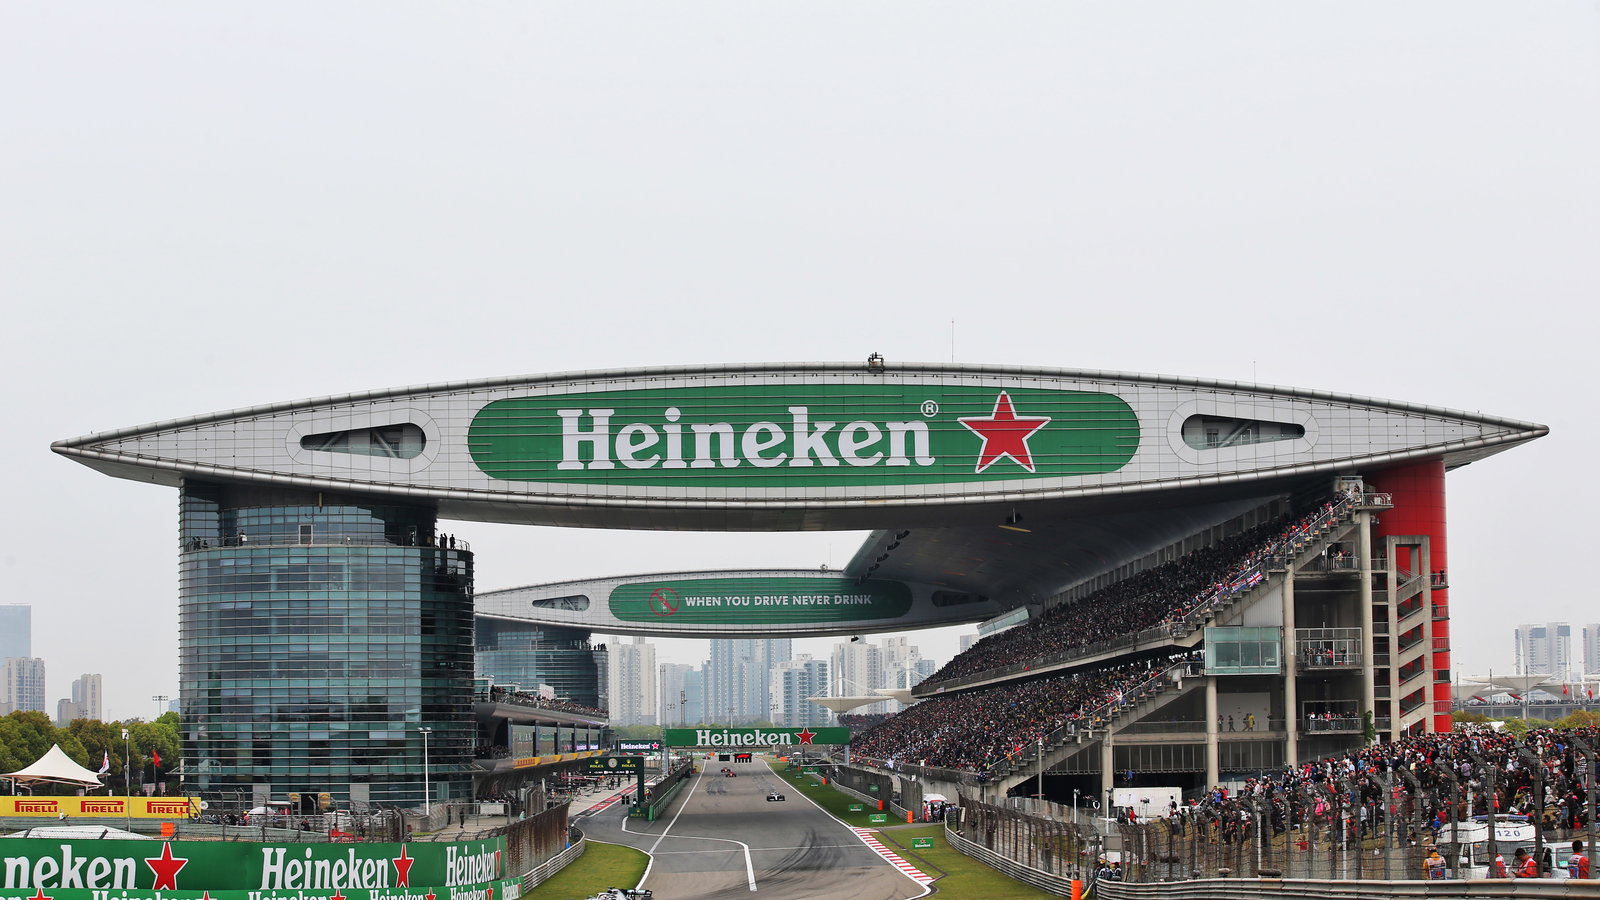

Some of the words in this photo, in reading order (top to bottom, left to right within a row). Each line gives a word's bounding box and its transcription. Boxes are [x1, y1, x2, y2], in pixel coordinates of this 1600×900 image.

[684, 596, 721, 607] WHEN
[724, 596, 750, 606] YOU
[754, 595, 789, 606] DRIVE
[792, 595, 831, 605] NEVER
[834, 594, 872, 605] DRINK
[695, 729, 792, 746] Heineken
[15, 800, 58, 813] PIRELLI
[80, 800, 124, 813] PIRELLI
[259, 847, 389, 890] Heineken
[445, 844, 496, 887] Heineken
